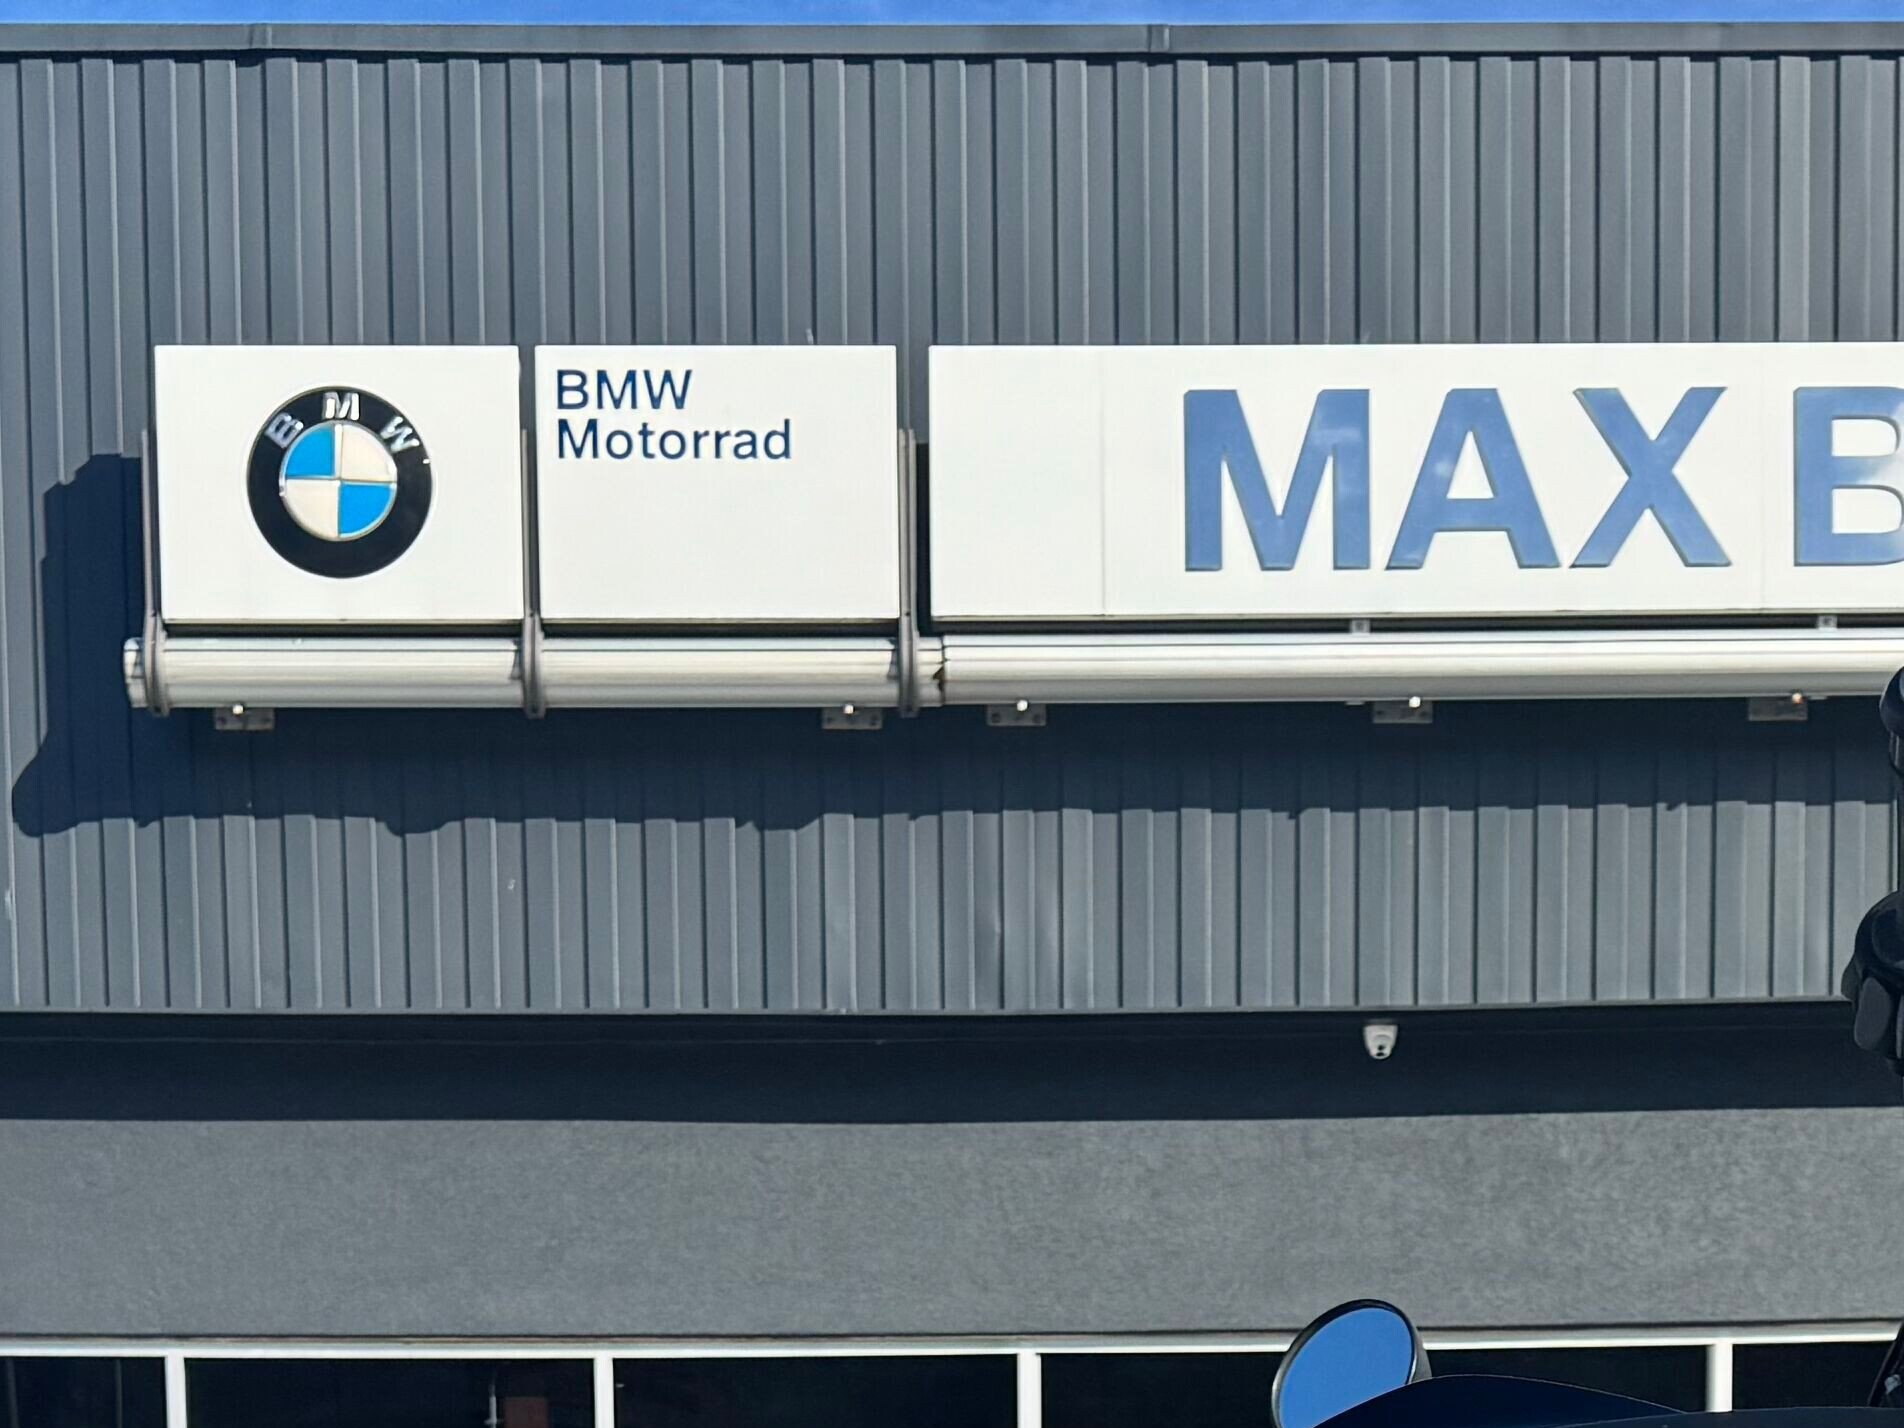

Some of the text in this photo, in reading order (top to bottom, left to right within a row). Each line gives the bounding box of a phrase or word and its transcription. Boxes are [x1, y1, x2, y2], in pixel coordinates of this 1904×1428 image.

[556, 368, 693, 410] BMW
[264, 390, 420, 454] BMW
[557, 417, 792, 461] Motorrad
[1182, 386, 1733, 572] MAX
